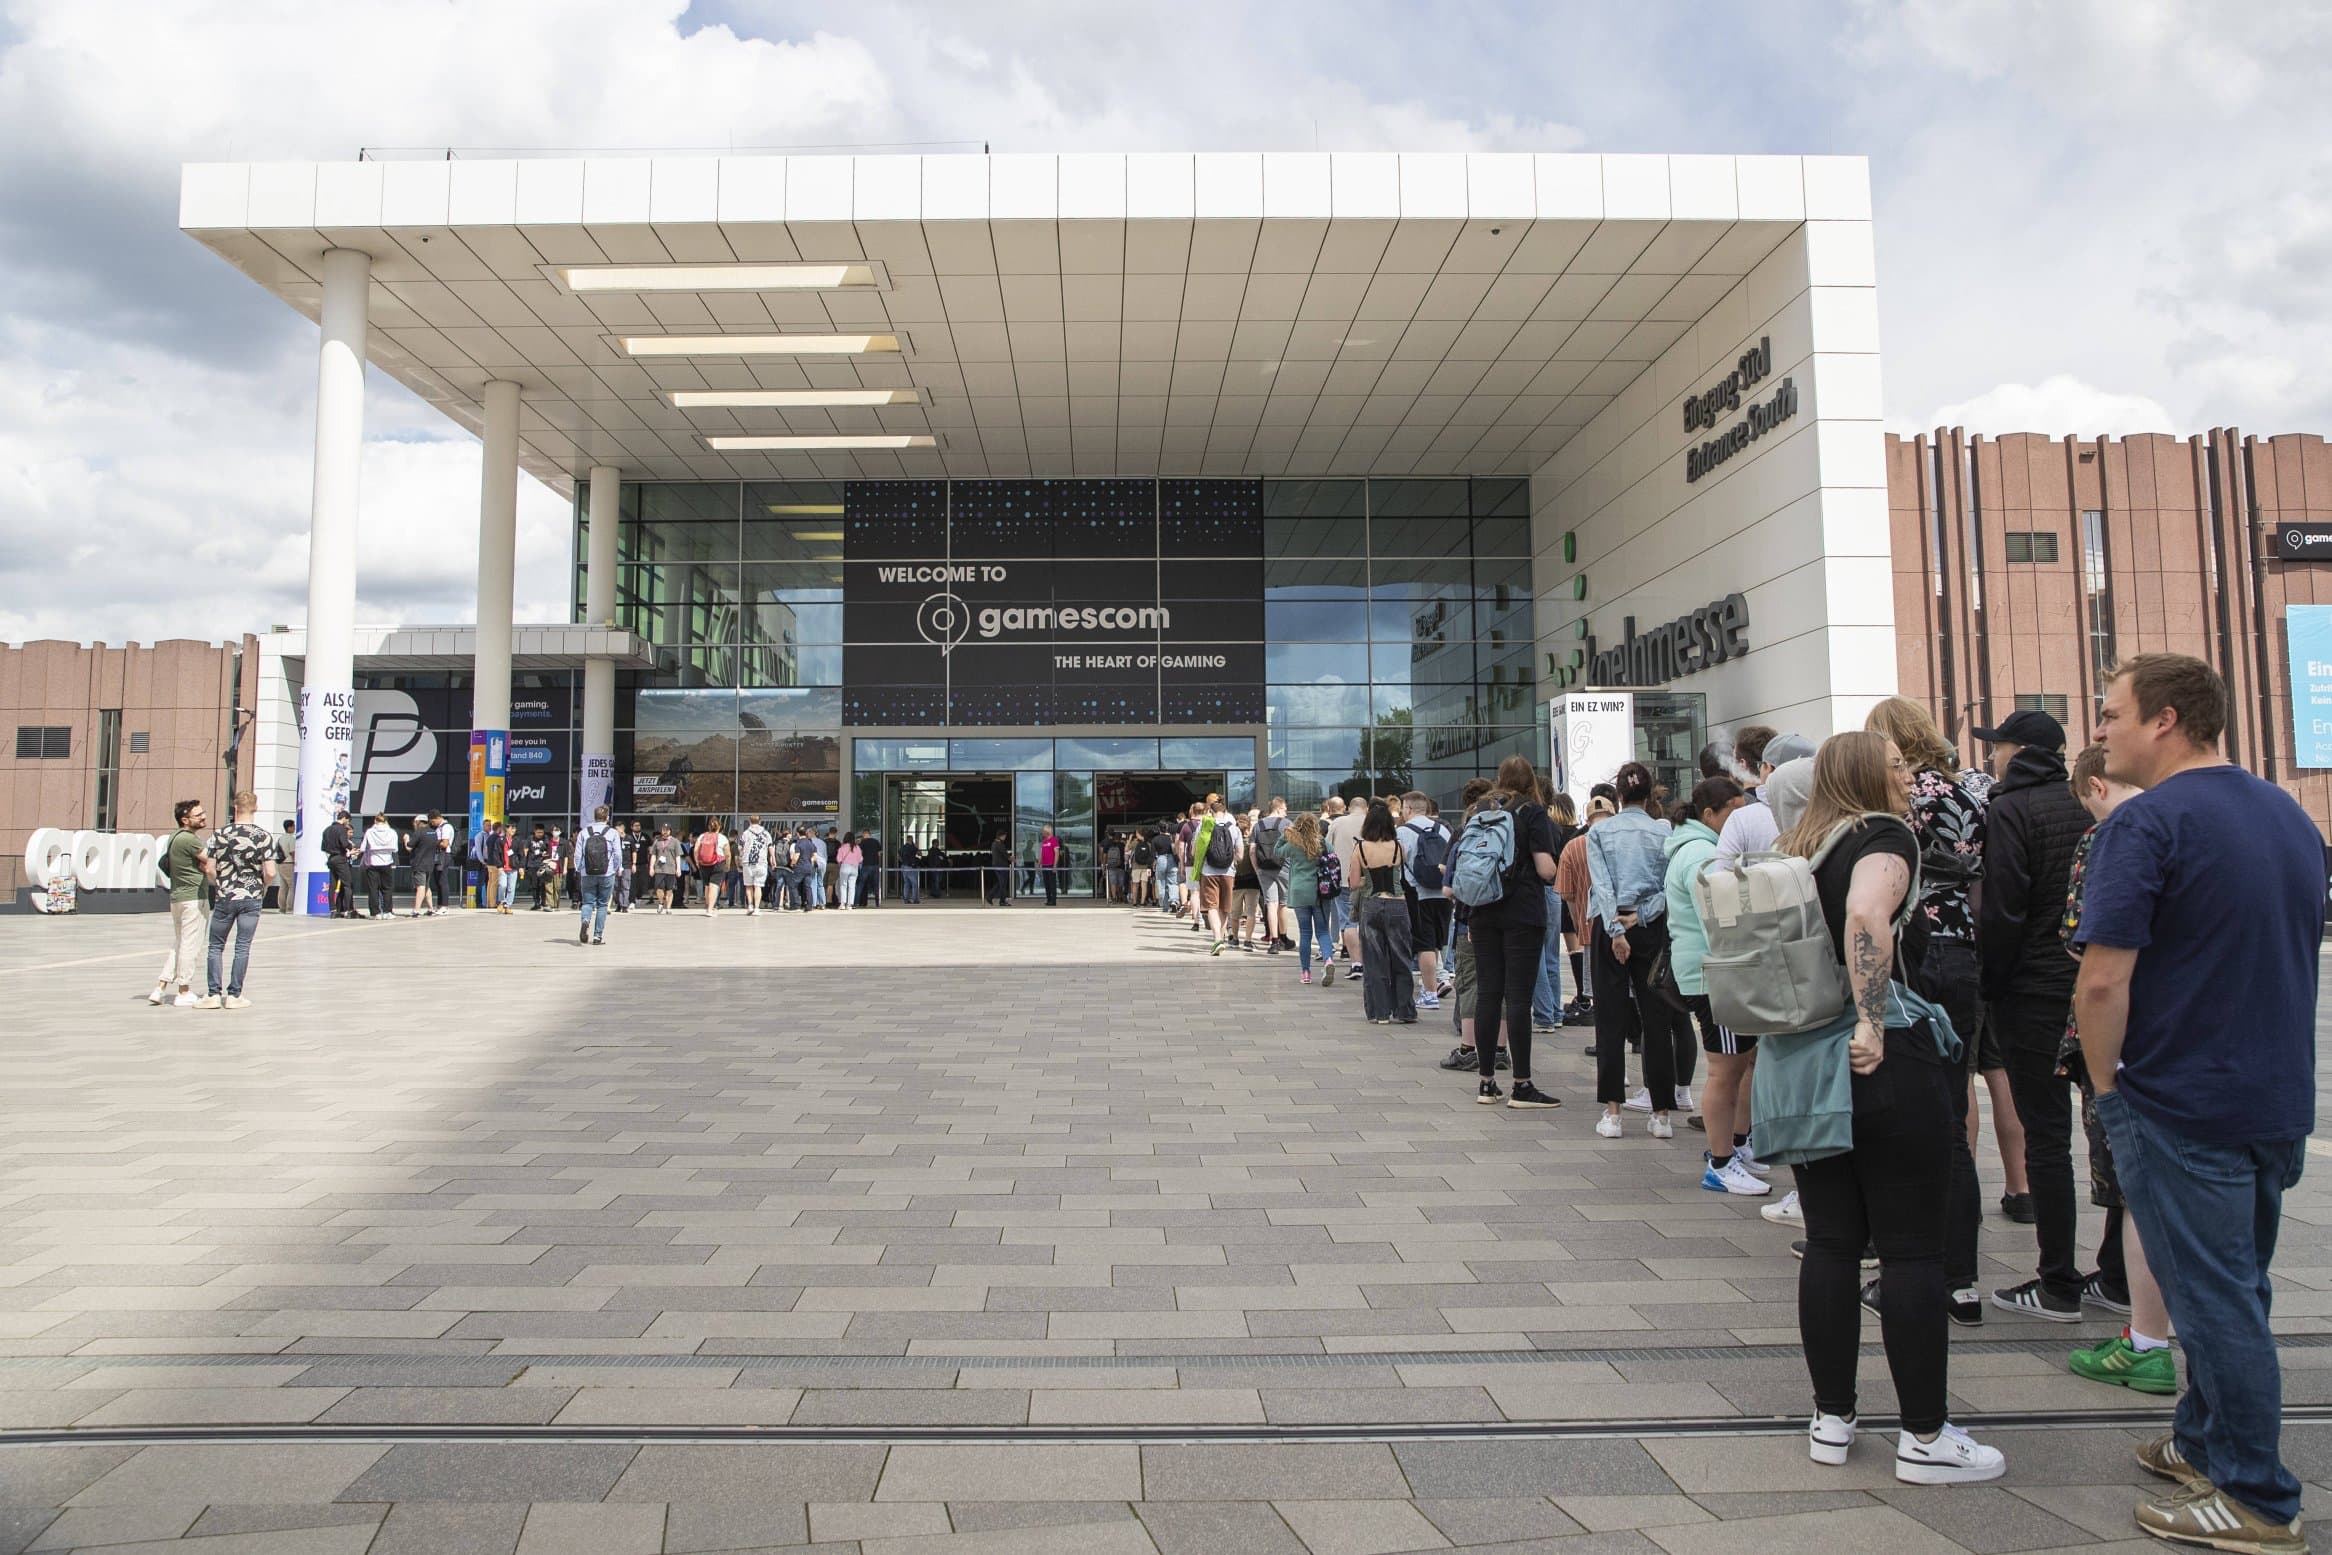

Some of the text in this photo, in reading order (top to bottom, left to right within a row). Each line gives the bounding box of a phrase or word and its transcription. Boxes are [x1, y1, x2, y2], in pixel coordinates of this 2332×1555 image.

[1683, 336, 1771, 433] Eingang Süd
[1687, 377, 1798, 483] Entrance South
[878, 566, 1007, 583] WELCOME TO
[978, 607, 1170, 638] gamescom
[1584, 593, 1749, 686] koelnmesse
[1054, 655, 1226, 668] THE HEART OF GAMING
[323, 693, 344, 707] ALS
[514, 701, 549, 710] gaming.
[1571, 702, 1584, 712] EIN
[1587, 702, 1598, 712] EZ
[1601, 701, 1625, 712] WIN?
[525, 738, 539, 746] you
[588, 759, 607, 768] JEDES
[588, 769, 599, 777] EIN
[601, 769, 609, 777] EZ
